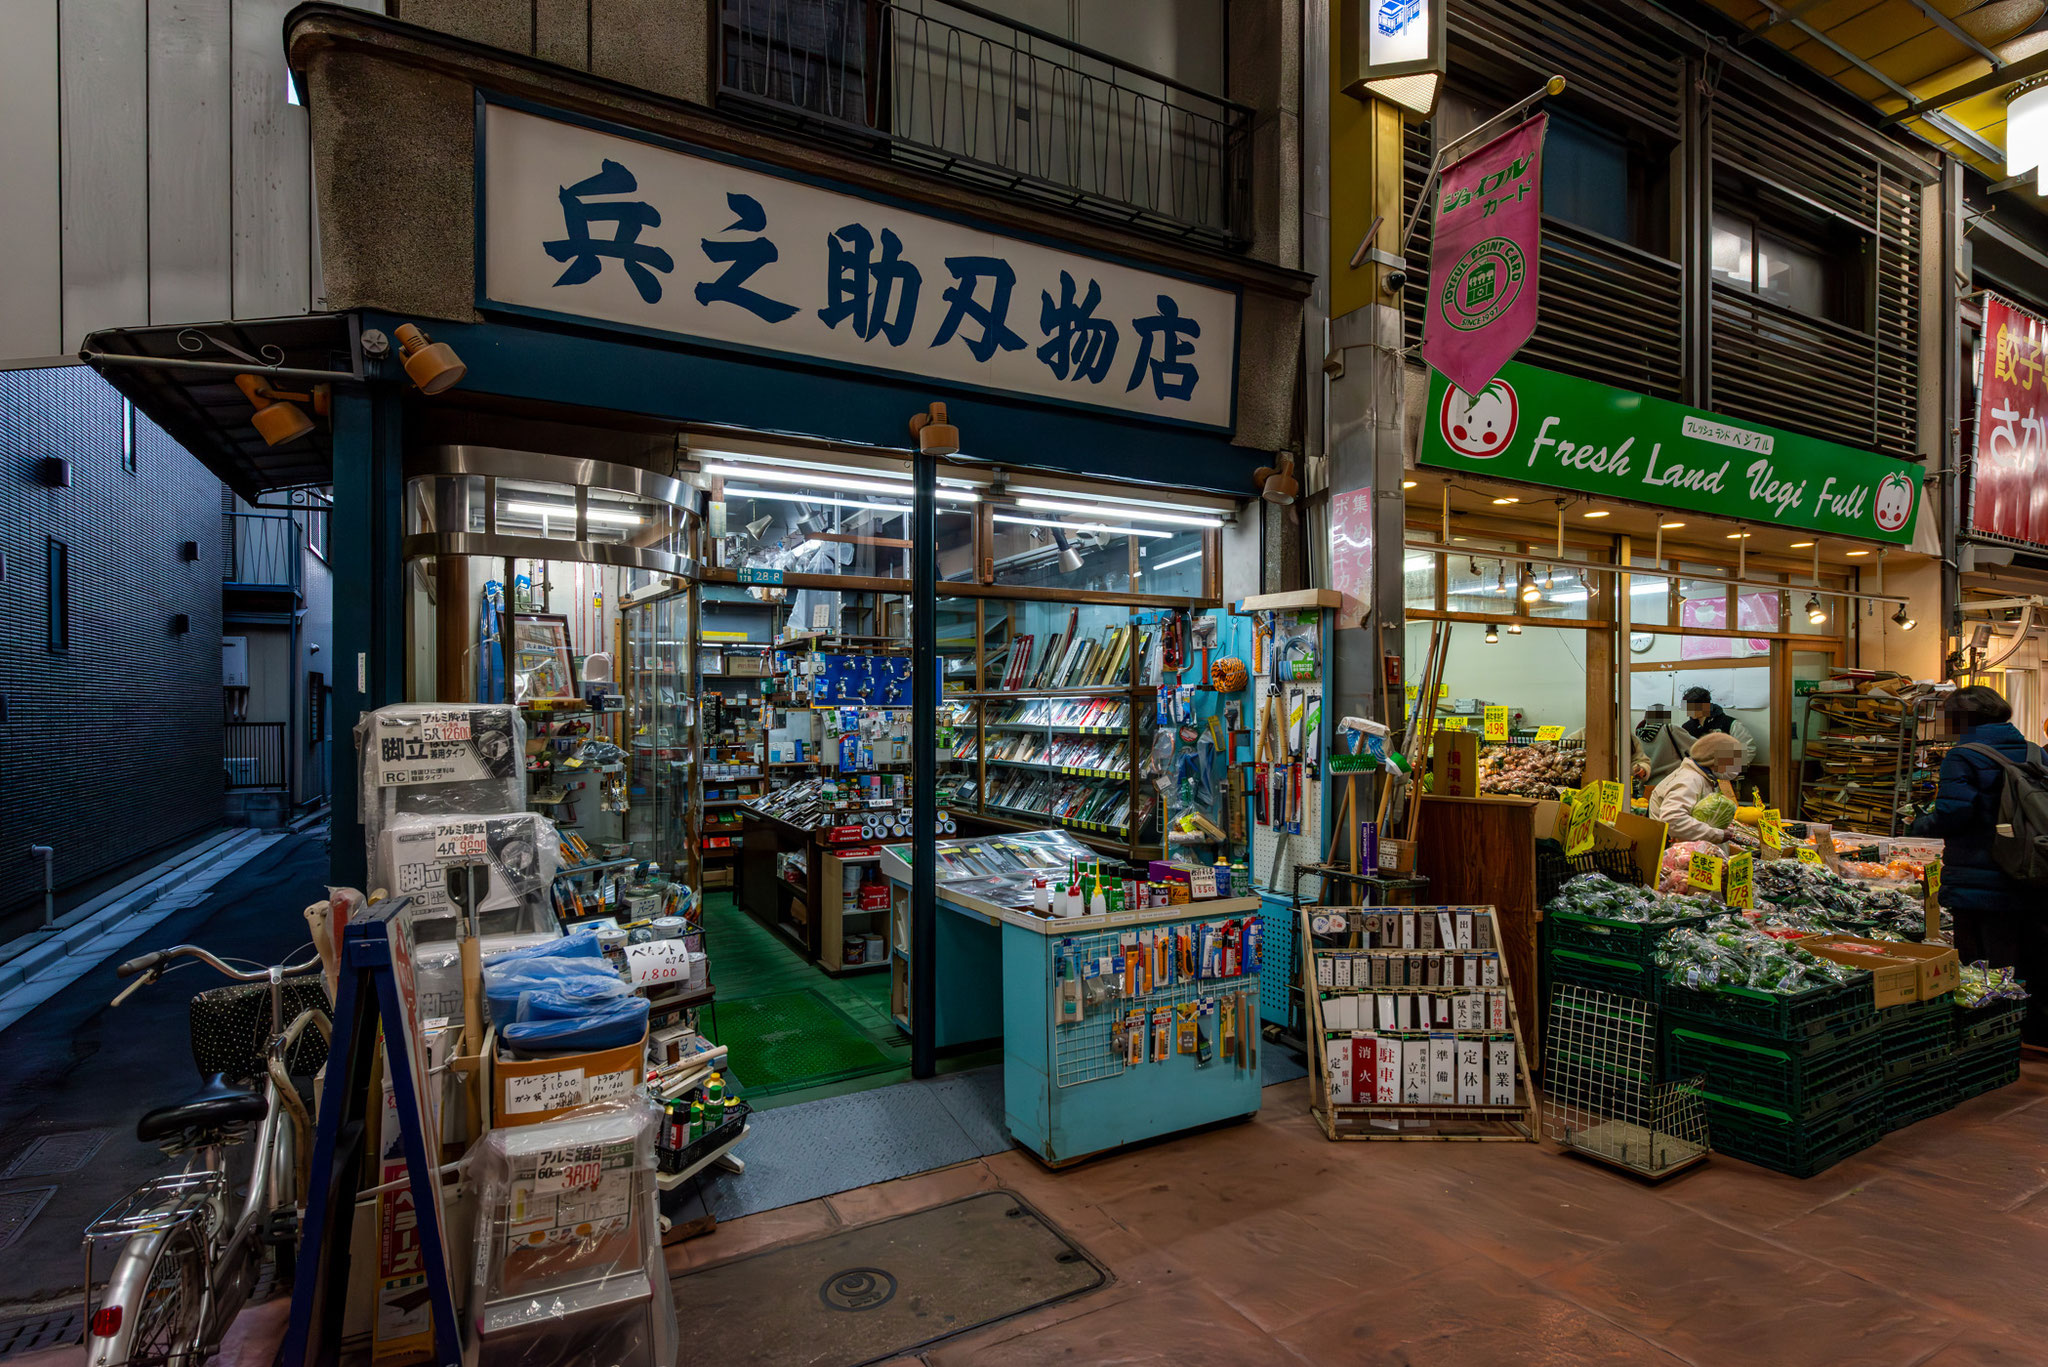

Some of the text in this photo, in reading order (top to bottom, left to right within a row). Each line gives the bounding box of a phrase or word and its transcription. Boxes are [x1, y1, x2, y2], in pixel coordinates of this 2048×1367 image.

[1442, 151, 1535, 215] ジョイフル
[1483, 179, 1532, 218] カード
[543, 158, 1201, 401] 兵之助刃物店
[1444, 239, 1522, 305] JOYFUL POINT CARD
[1994, 322, 2048, 392] 餃子
[1527, 415, 1868, 519] Fresh Land Vegi Full
[756, 571, 780, 581] 28-8
[422, 712, 469, 723] アルミ脚立
[442, 727, 472, 740] 12600
[382, 736, 428, 761] 脚立
[386, 772, 405, 782] RC
[437, 824, 486, 836] アルミ脚立
[437, 842, 457, 855] 4尺
[1691, 855, 1716, 870] とまと
[1459, 920, 1469, 949] 出入口
[1358, 1045, 1372, 1104] 消火器
[1378, 1047, 1395, 1102] 駐車禁
[1463, 1049, 1478, 1104] 定休日
[1495, 1050, 1510, 1104] 営業中
[541, 1144, 602, 1166] アルミ踏台
[561, 1161, 602, 1189] 3800
